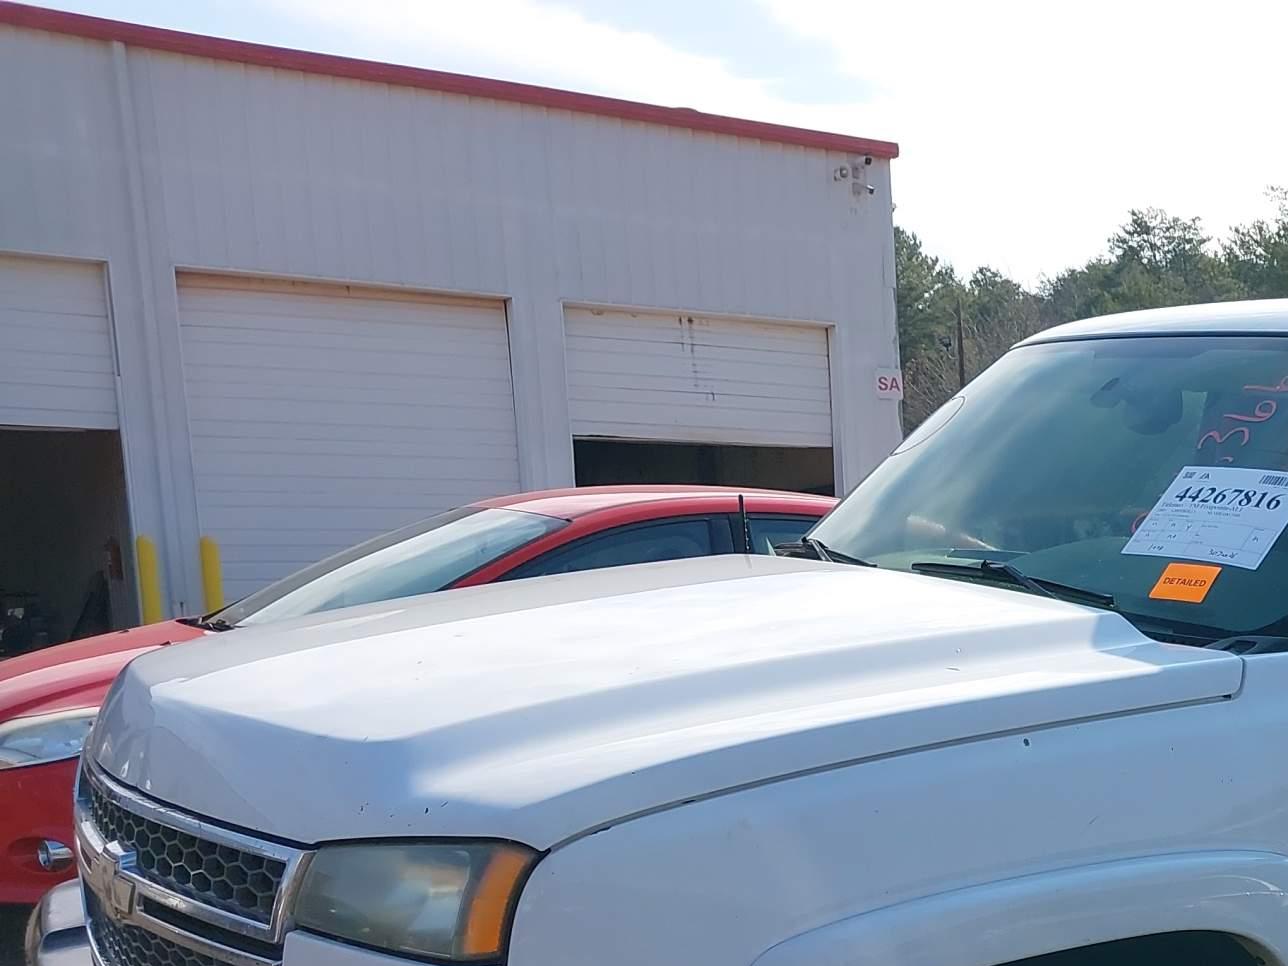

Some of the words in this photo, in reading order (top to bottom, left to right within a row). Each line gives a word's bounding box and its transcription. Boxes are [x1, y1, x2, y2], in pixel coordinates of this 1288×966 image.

[877, 376, 901, 392] SA
[1175, 486, 1287, 511] 44267816
[1162, 576, 1207, 588] DETAILED
